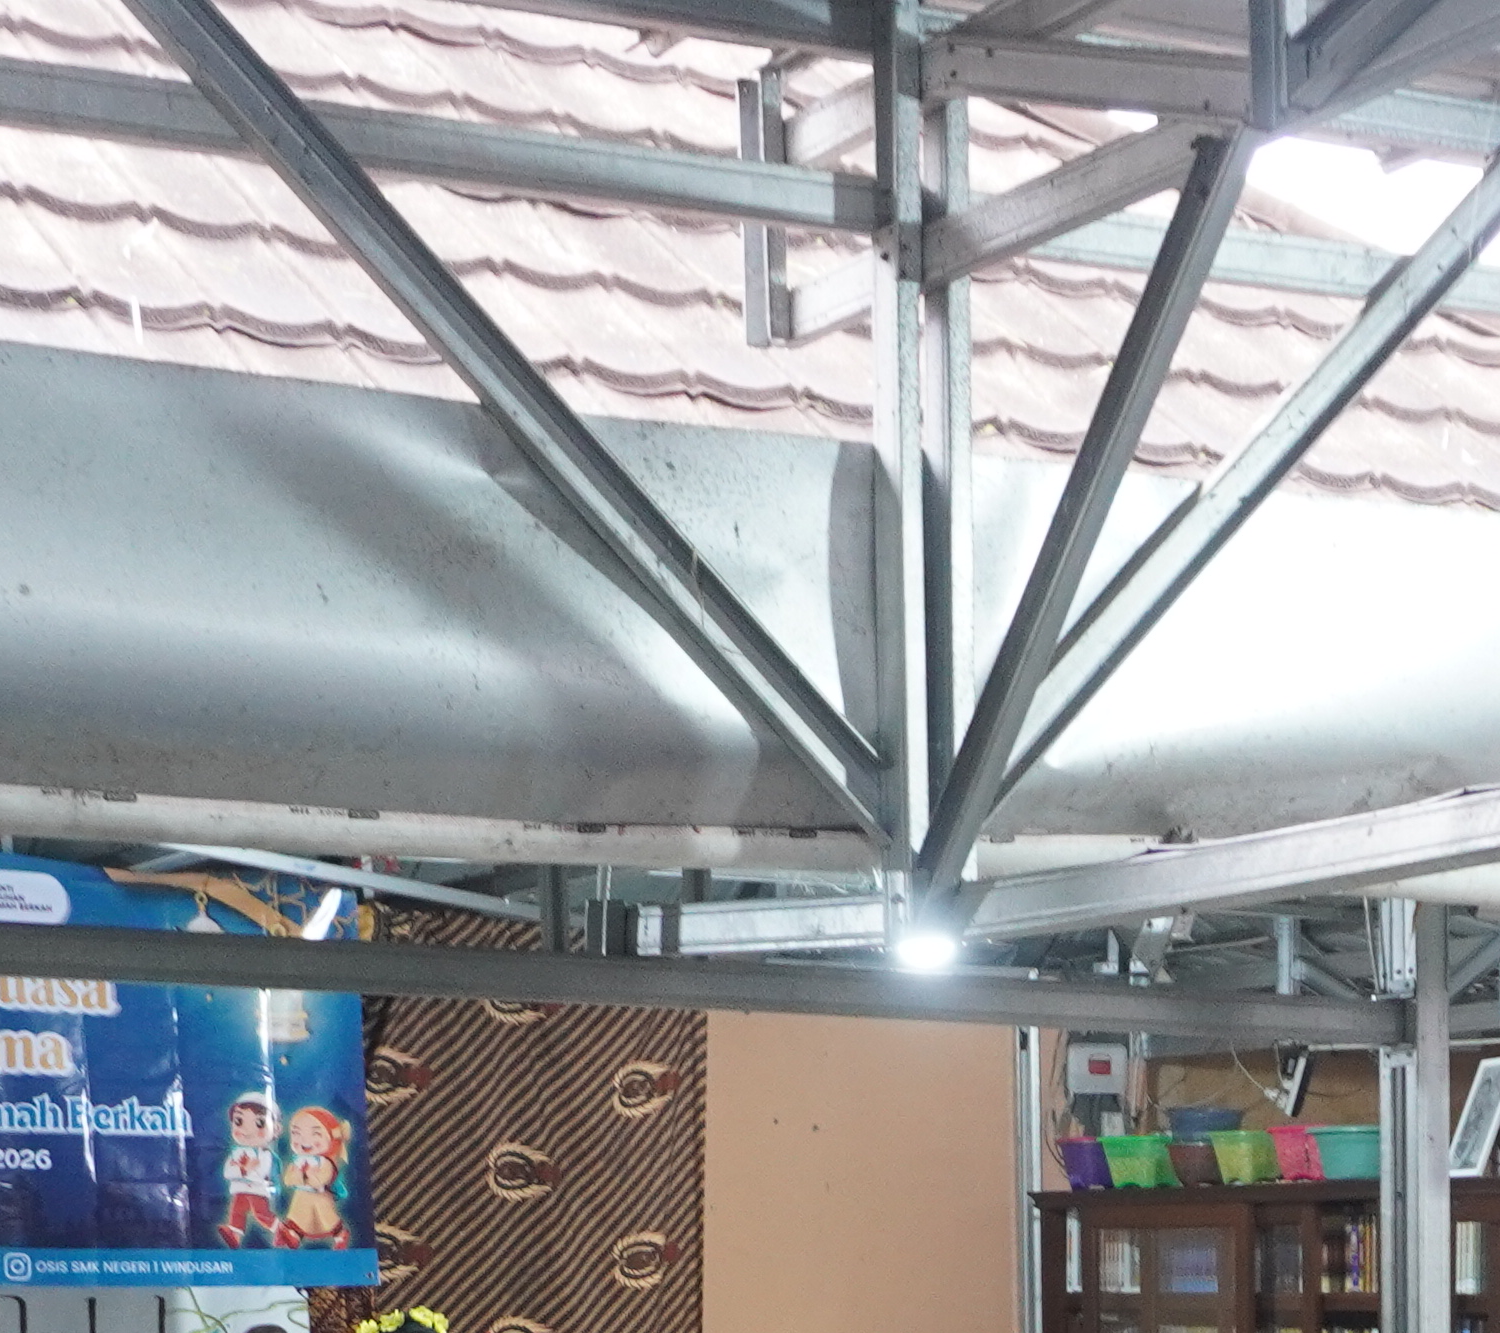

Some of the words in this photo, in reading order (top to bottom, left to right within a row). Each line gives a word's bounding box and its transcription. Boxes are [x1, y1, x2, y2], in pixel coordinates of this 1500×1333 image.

[67, 1096, 195, 1139] Berkah
[35, 1261, 67, 1275] OSIS
[69, 1261, 100, 1275] SMK
[102, 1261, 151, 1275] NEGERI
[161, 1261, 235, 1276] WINDUSARI
